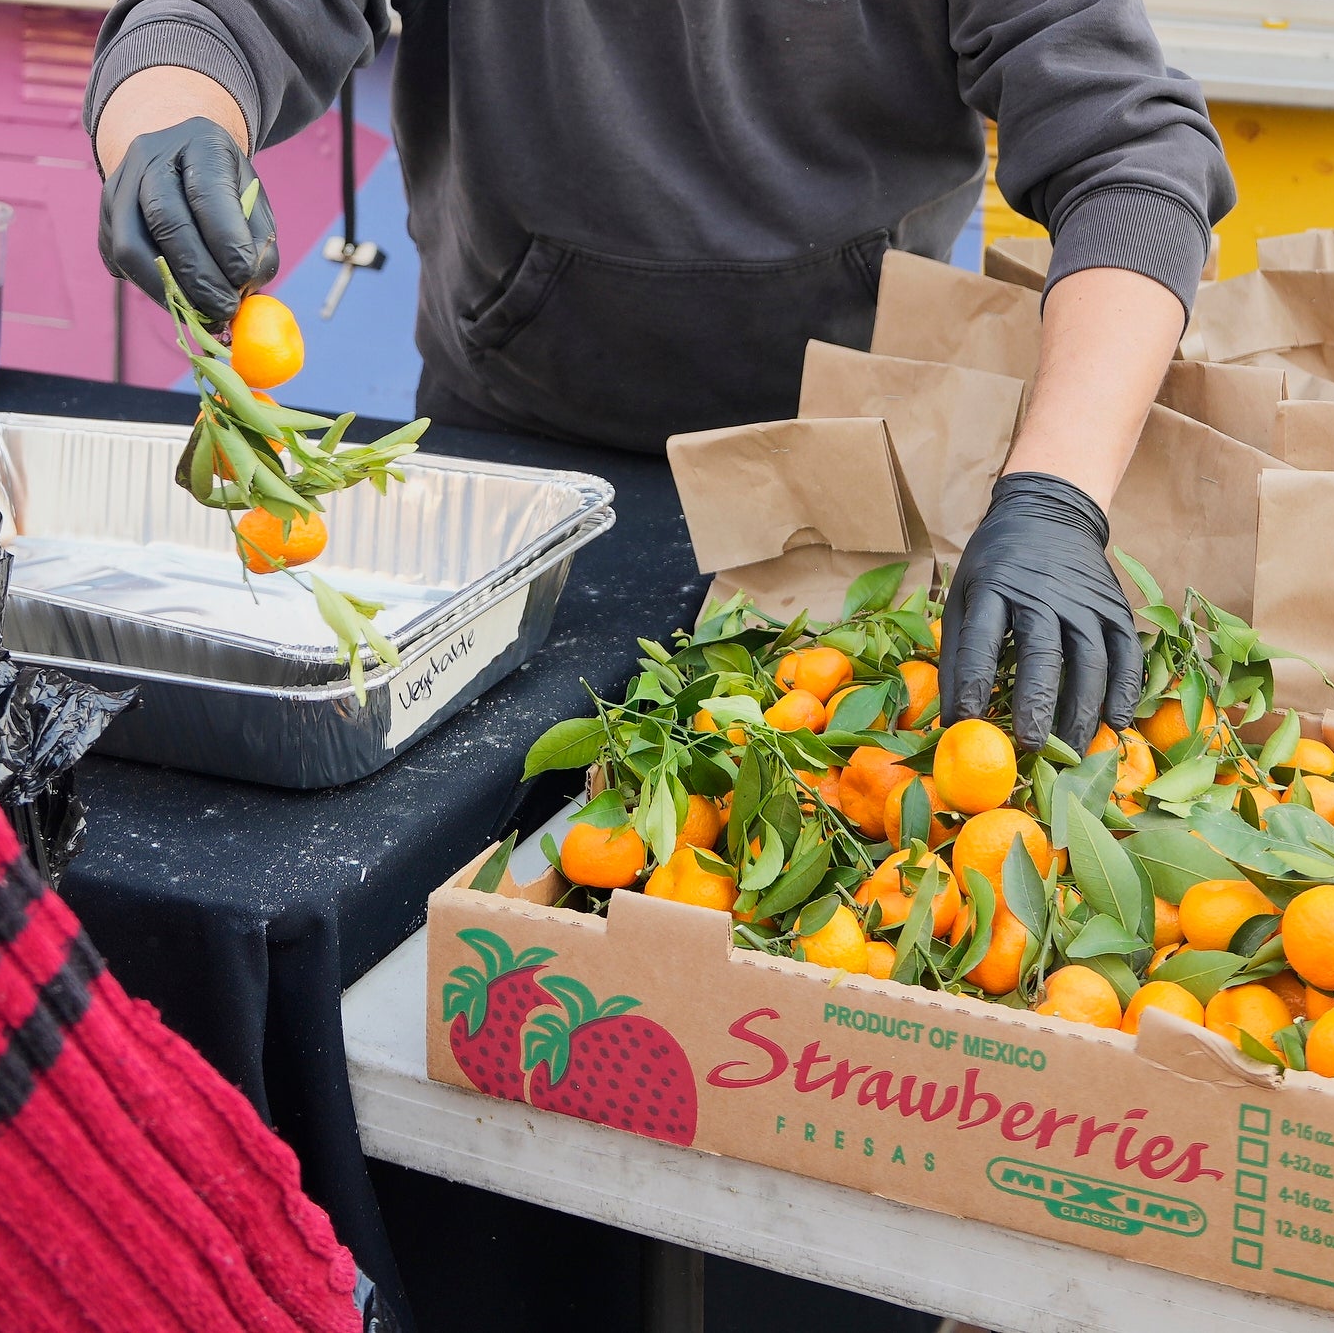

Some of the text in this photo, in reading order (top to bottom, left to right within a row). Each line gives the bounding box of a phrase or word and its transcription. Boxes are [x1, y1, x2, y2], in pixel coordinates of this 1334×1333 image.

[824, 1003, 1047, 1072] PRODUCT OF MEXICO
[706, 1007, 1225, 1183] Strawberries
[776, 1115, 936, 1172] FRESAS
[1281, 1119, 1313, 1140] 8-16
[1317, 1131, 1334, 1147] oz.
[1279, 1152, 1310, 1173] 4-32
[1312, 1163, 1333, 1178] oz.
[1279, 1187, 1310, 1209] 4-16
[1060, 1206, 1128, 1230] CLASSIC
